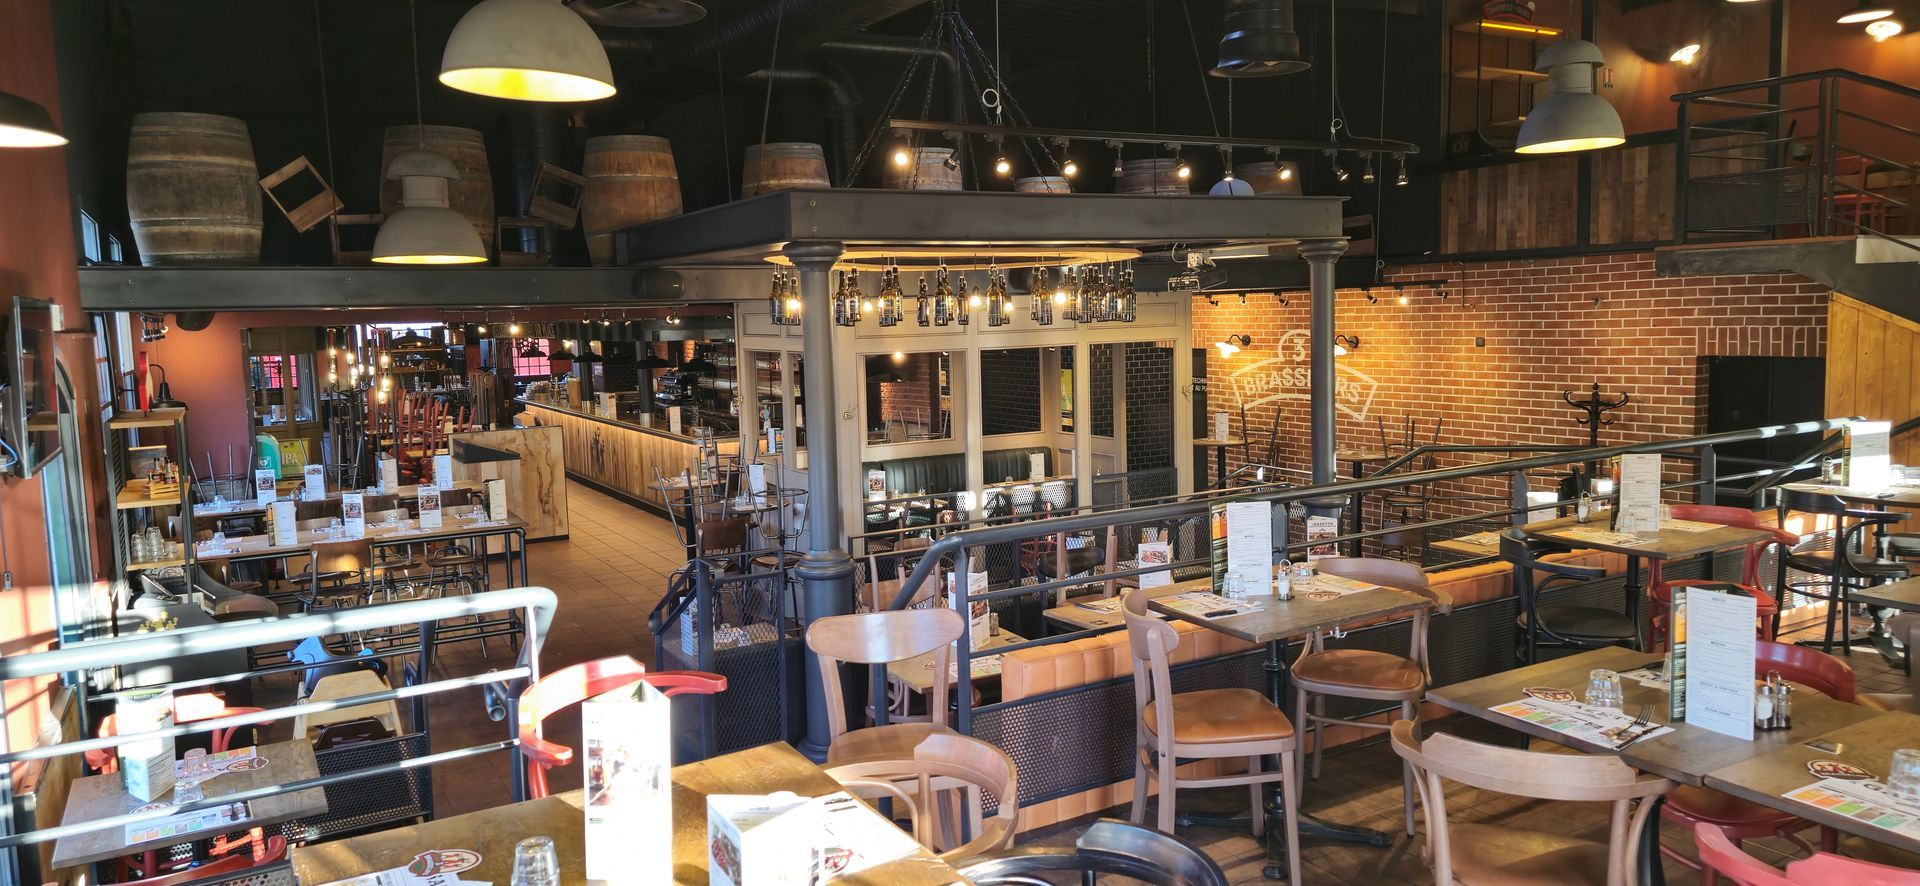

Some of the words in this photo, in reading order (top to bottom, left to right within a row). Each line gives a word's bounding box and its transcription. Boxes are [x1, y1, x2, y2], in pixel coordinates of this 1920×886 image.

[1293, 338, 1306, 361] 3
[1243, 368, 1361, 402] BRASSRS
[282, 453, 298, 465] IPA
